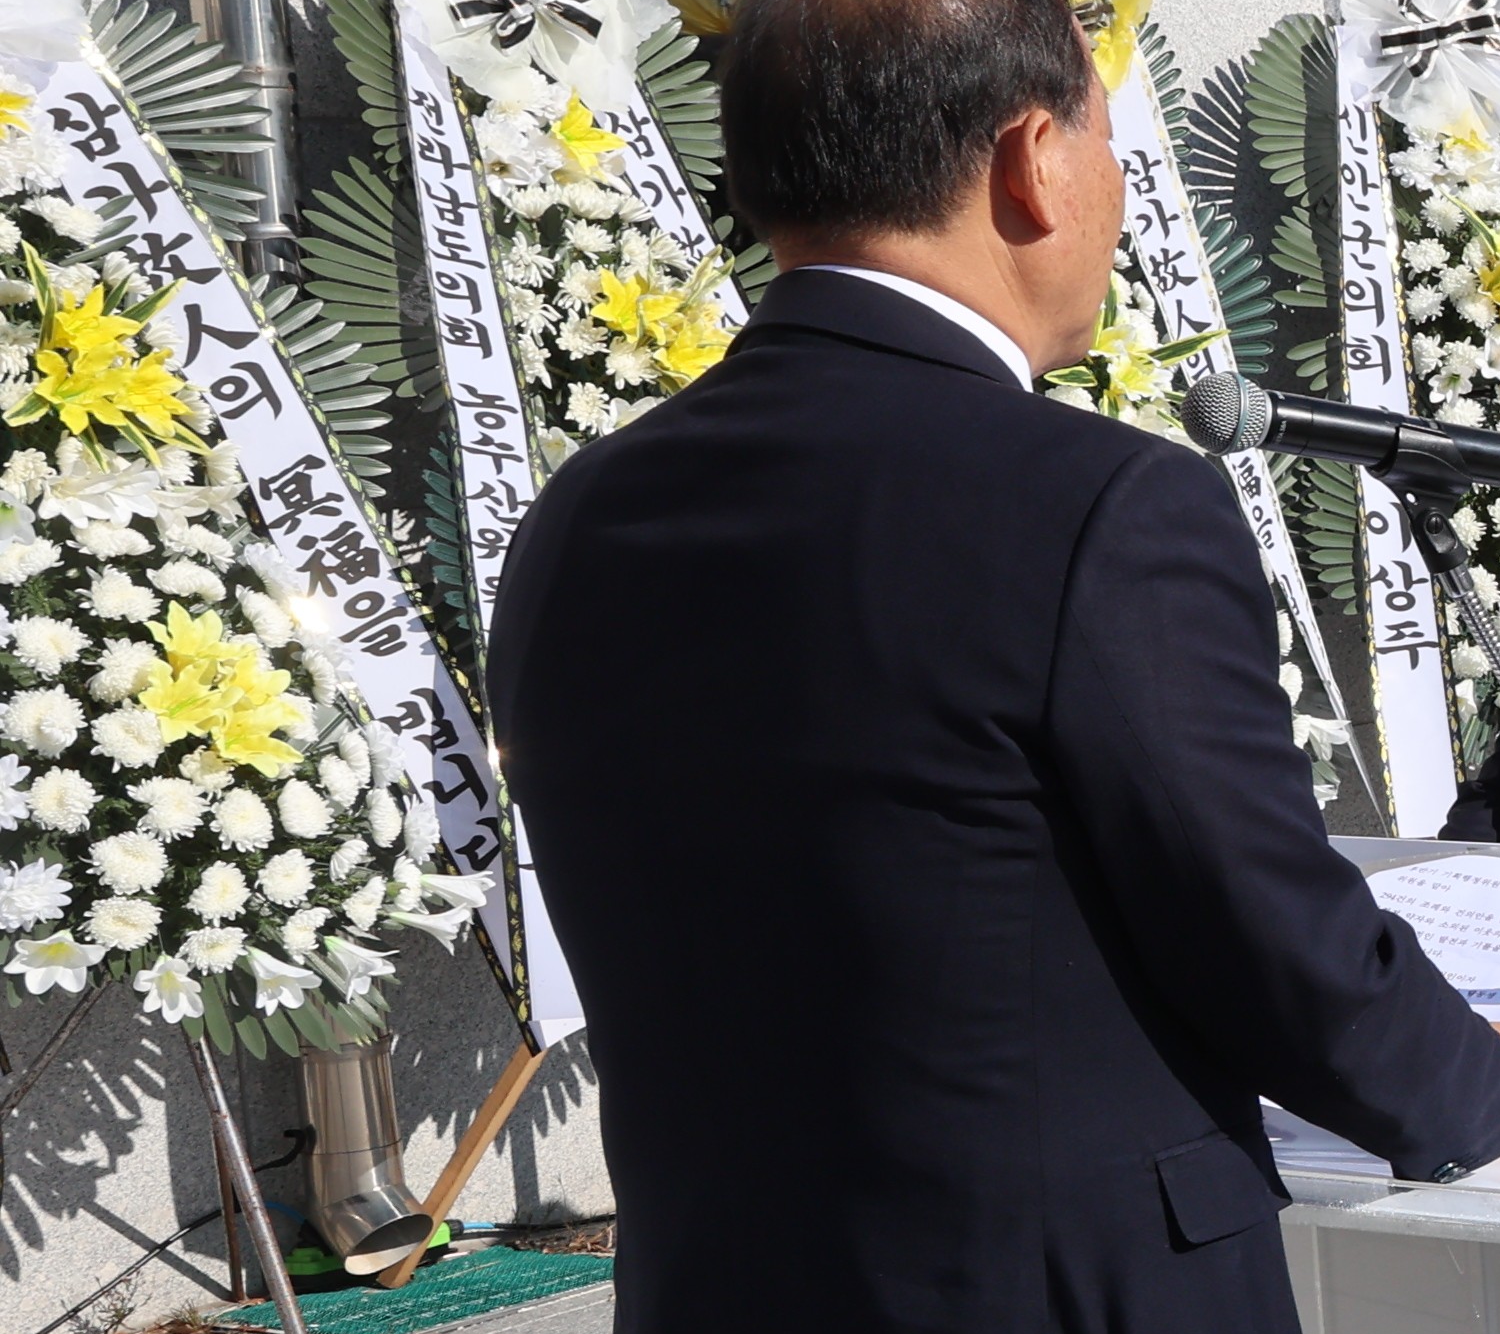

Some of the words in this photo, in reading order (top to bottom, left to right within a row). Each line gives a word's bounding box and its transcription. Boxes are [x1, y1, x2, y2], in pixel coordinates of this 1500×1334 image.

[411, 86, 499, 360] 전라남도의회
[1120, 149, 1181, 240] 삼가
[1339, 104, 1392, 386] 신안군의회
[46, 92, 169, 223] 삼가
[259, 454, 409, 657] 冥福을
